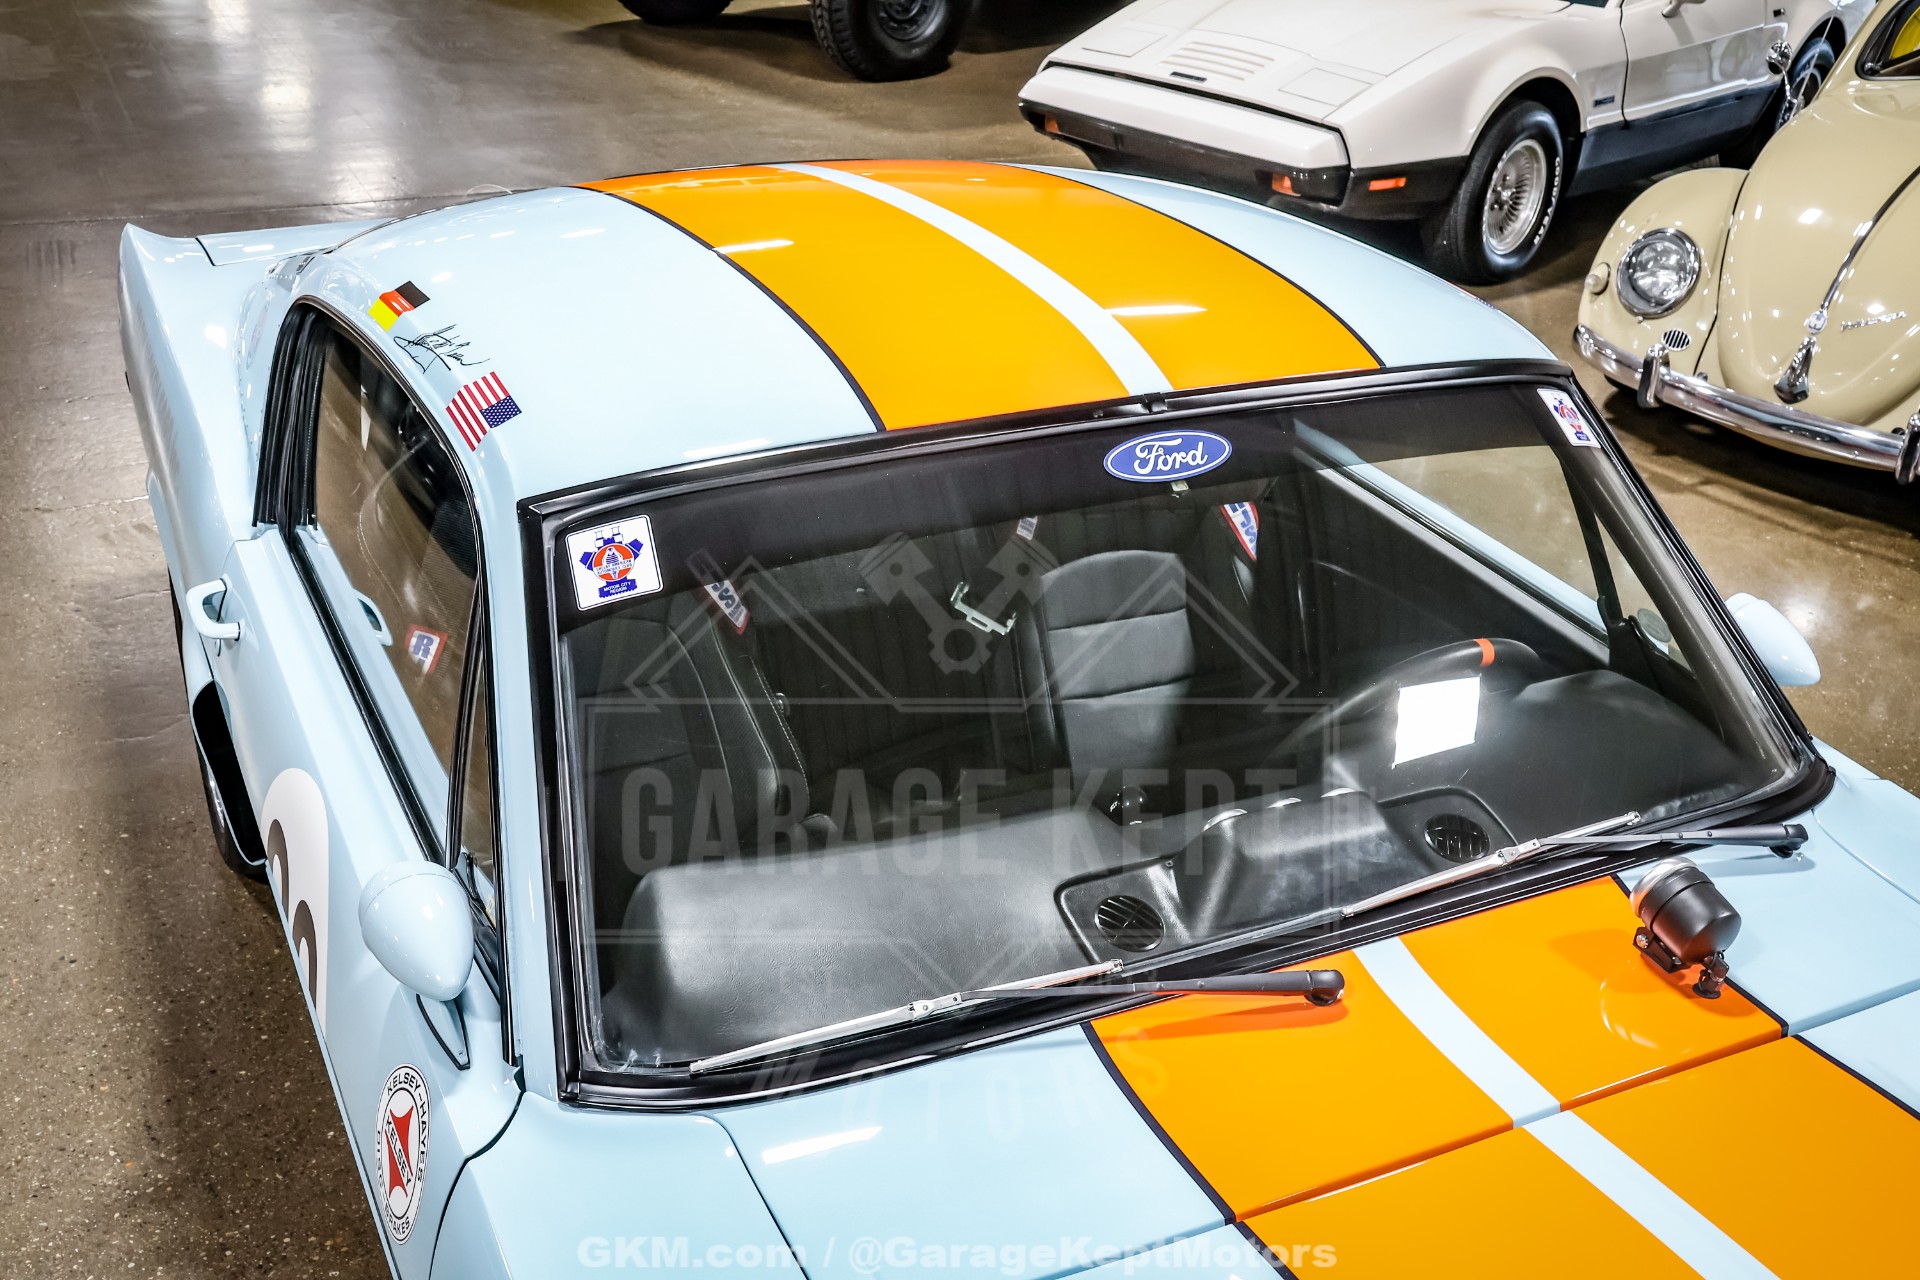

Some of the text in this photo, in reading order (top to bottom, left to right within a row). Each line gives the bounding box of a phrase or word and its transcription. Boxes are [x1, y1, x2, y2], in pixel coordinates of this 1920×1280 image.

[1534, 156, 1560, 245] GOODYEAR
[1134, 438, 1208, 475] Ford
[386, 1115, 412, 1186] KELSEY
